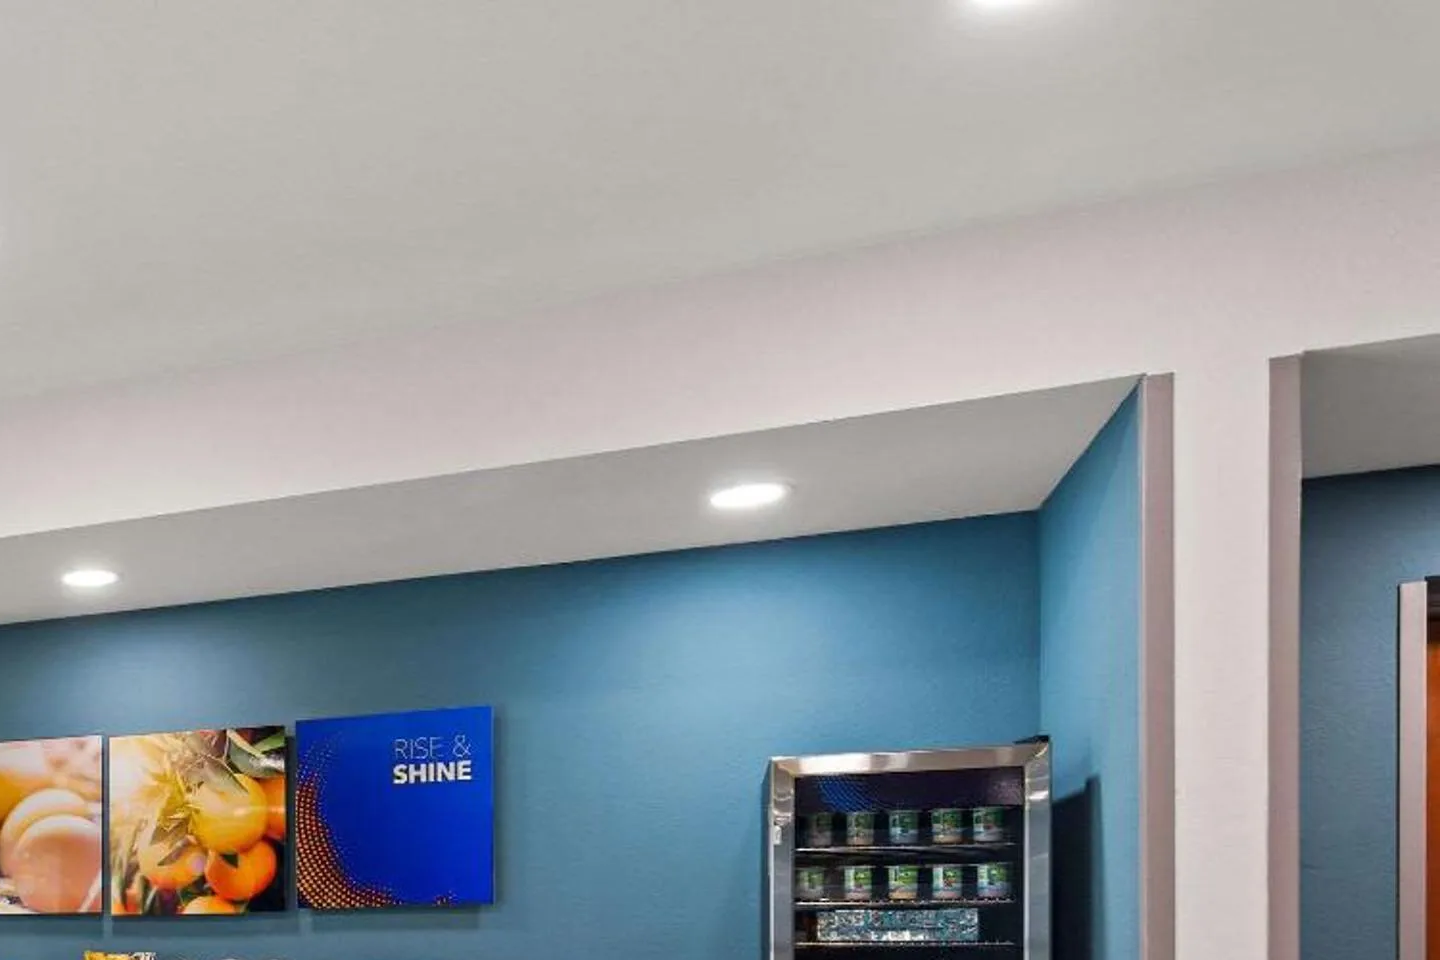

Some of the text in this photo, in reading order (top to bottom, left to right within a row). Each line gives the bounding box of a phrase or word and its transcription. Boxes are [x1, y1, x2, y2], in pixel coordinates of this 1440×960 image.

[394, 734, 472, 760] RISE &
[393, 760, 472, 785] SHINE
